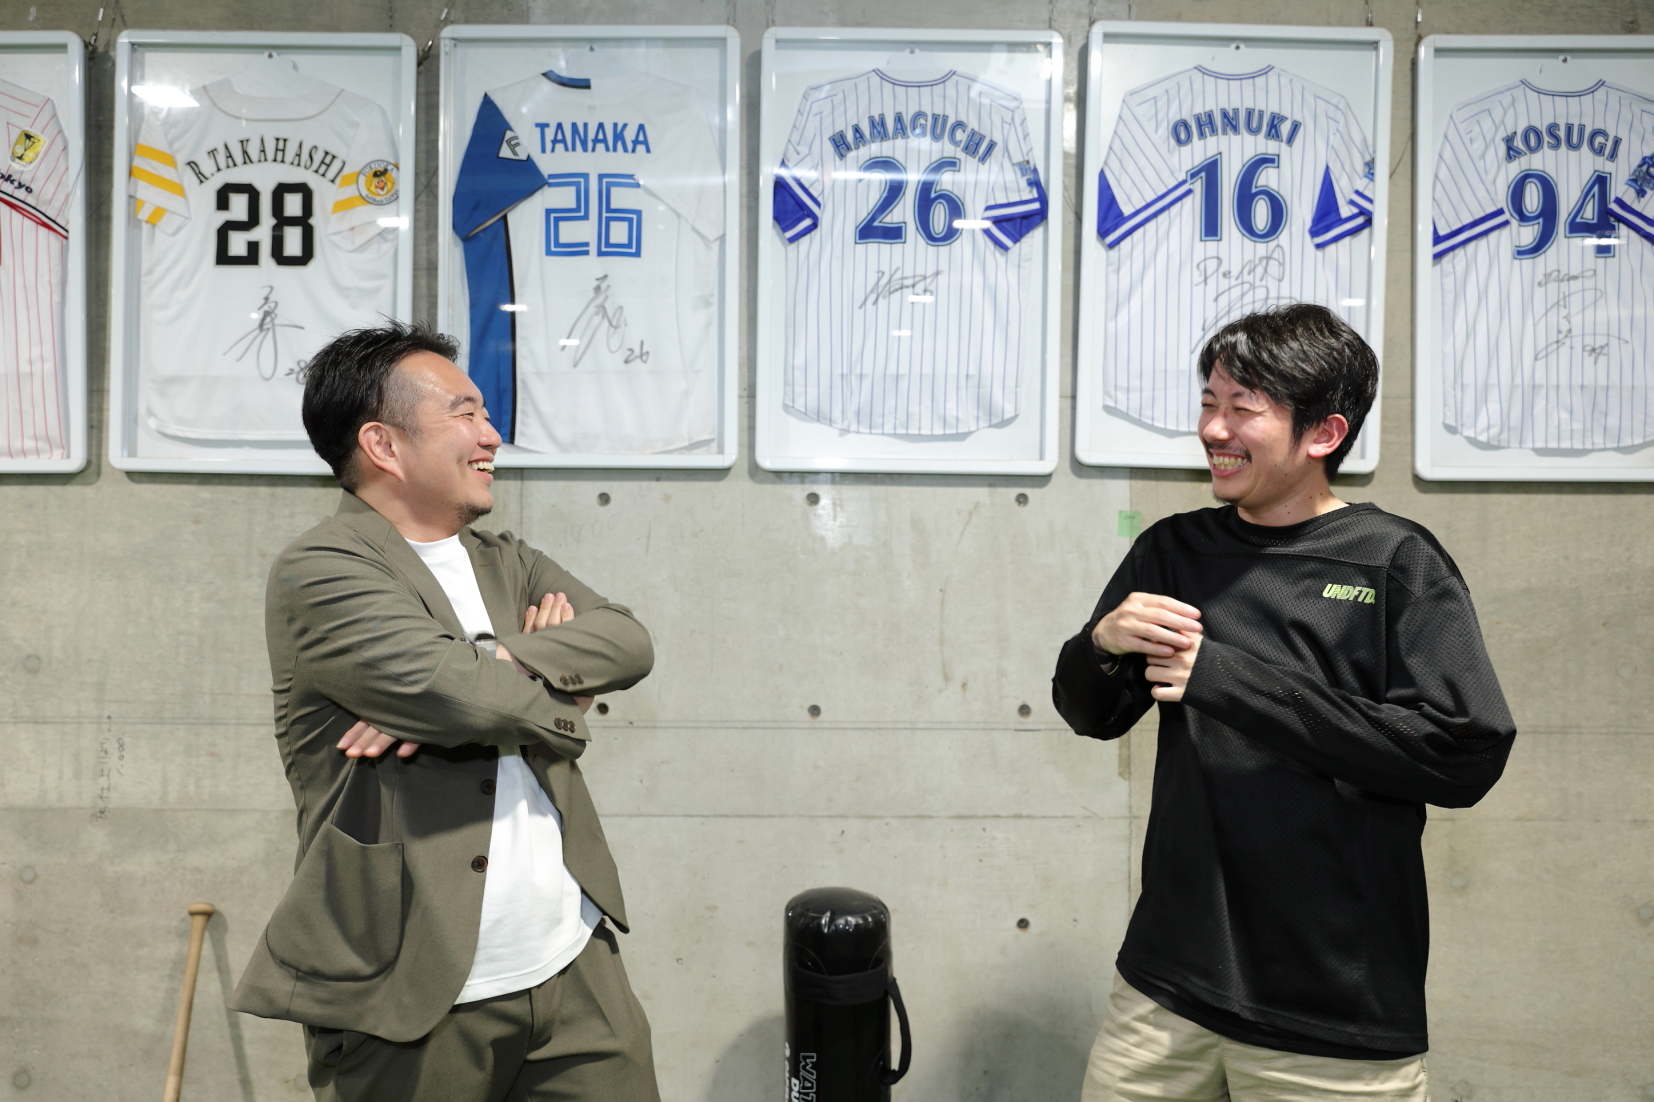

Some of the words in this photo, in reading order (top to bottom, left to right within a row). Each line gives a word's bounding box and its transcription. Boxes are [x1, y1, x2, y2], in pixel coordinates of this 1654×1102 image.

[535, 122, 651, 154] TANAKA
[829, 111, 997, 165] HAMAGUCHI
[1171, 108, 1301, 147] OHNUKI
[1502, 123, 1622, 163] KOSUGI
[0, 171, 33, 194] okyo
[185, 135, 346, 186] R.TAKAHASHI
[545, 173, 642, 257] 26
[855, 157, 965, 246] 26
[1186, 152, 1287, 243] 16
[1507, 169, 1619, 259] 94
[214, 182, 314, 267] 28
[623, 340, 649, 364] 26
